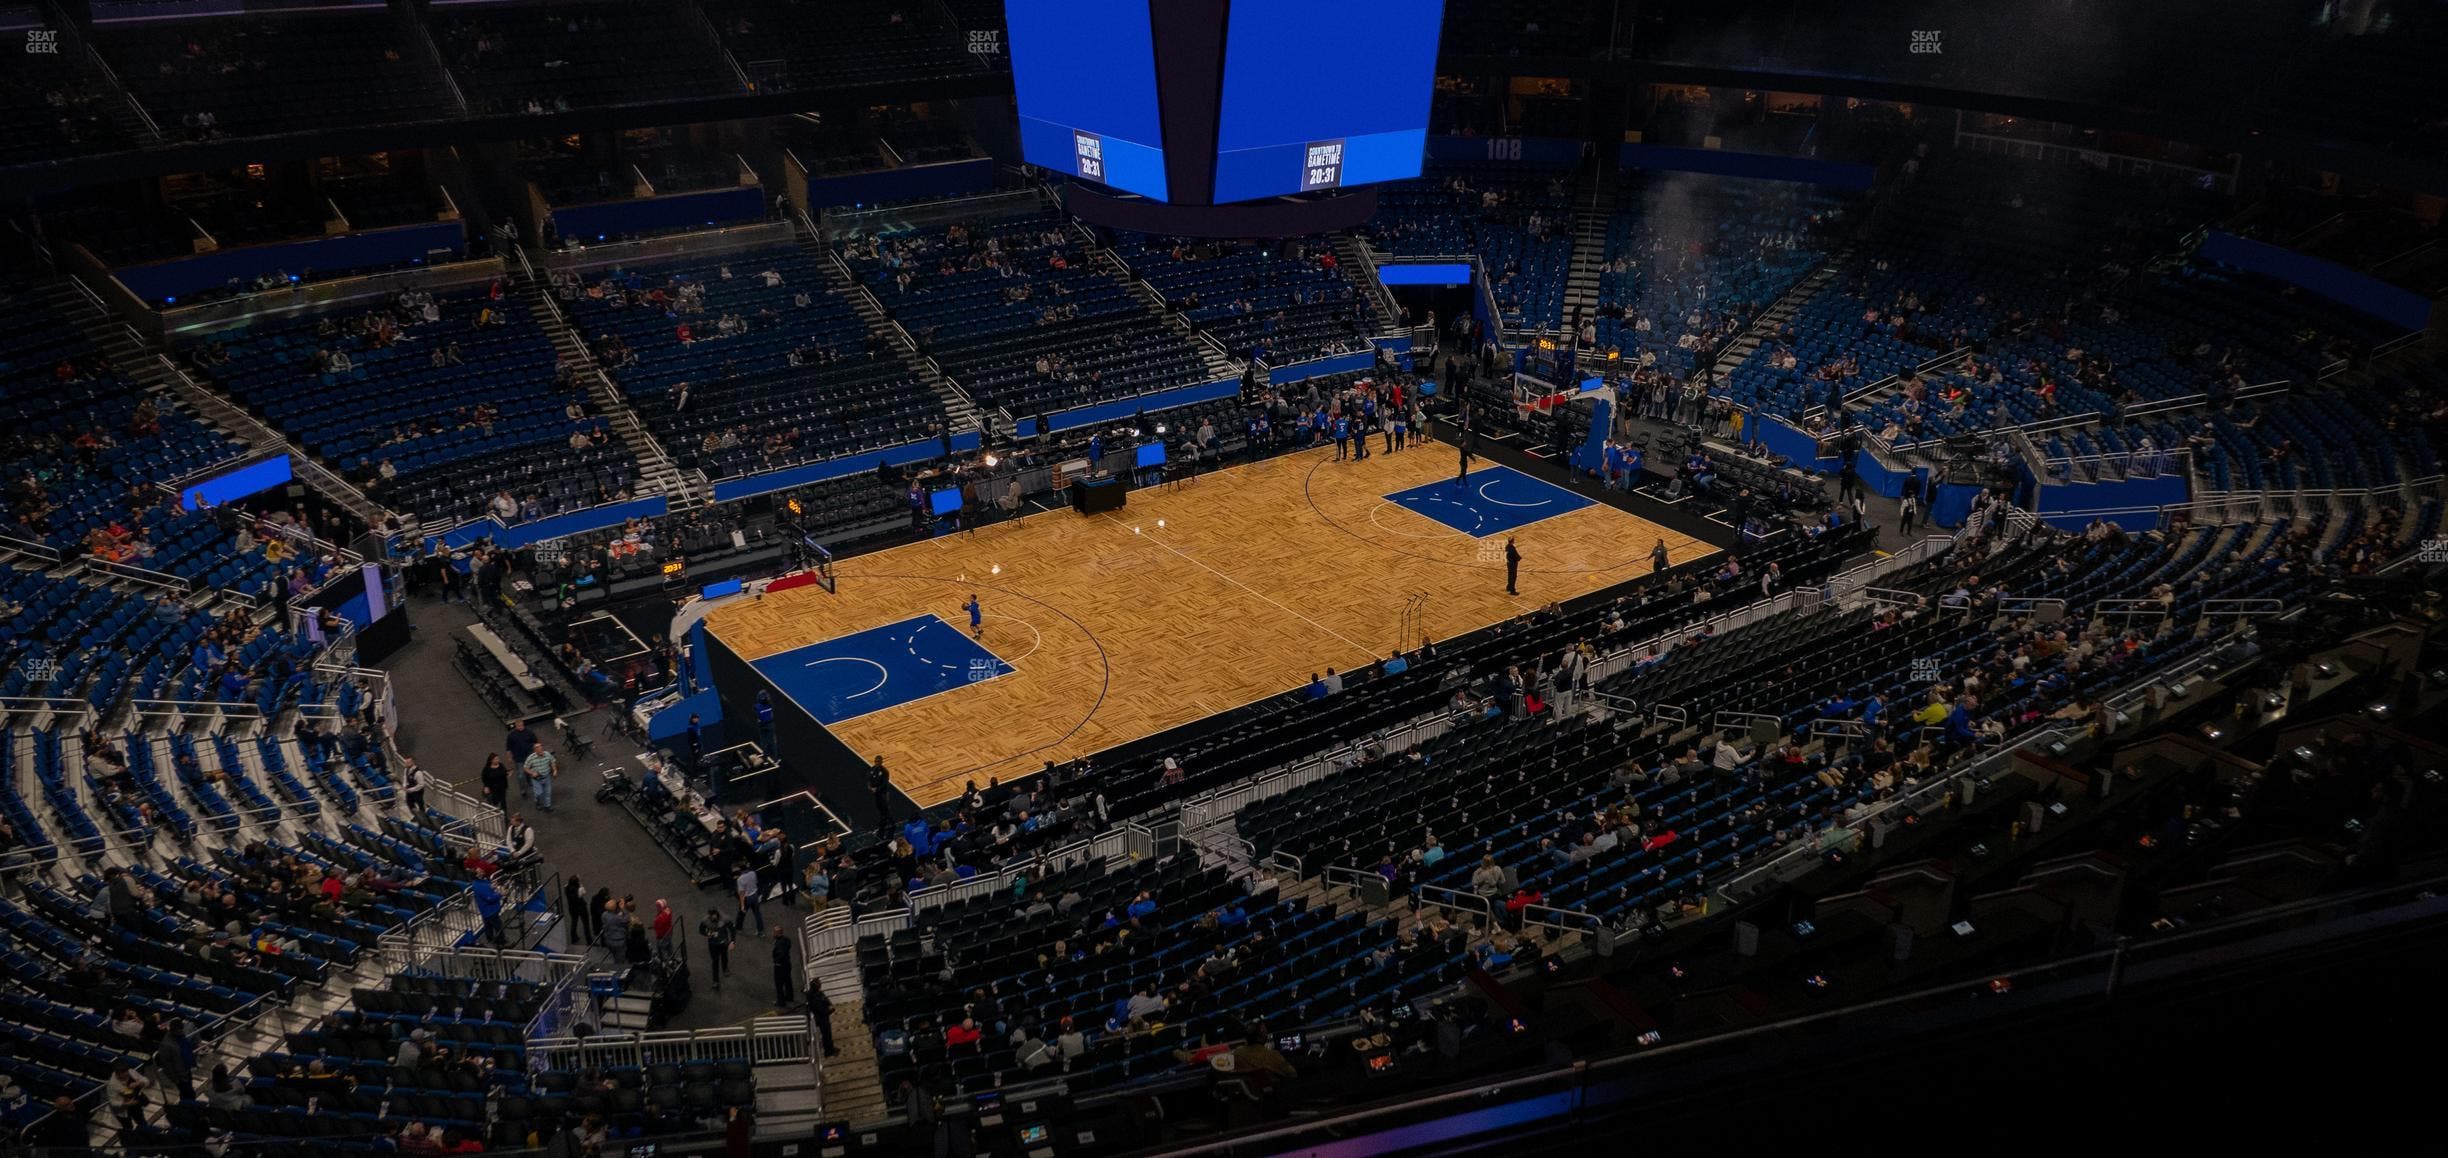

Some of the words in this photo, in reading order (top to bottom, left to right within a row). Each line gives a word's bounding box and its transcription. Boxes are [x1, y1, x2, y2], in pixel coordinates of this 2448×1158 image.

[1488, 138, 1522, 160] 108
[1307, 152, 1341, 168] GAMETIME
[1309, 167, 1335, 185] 20:31
